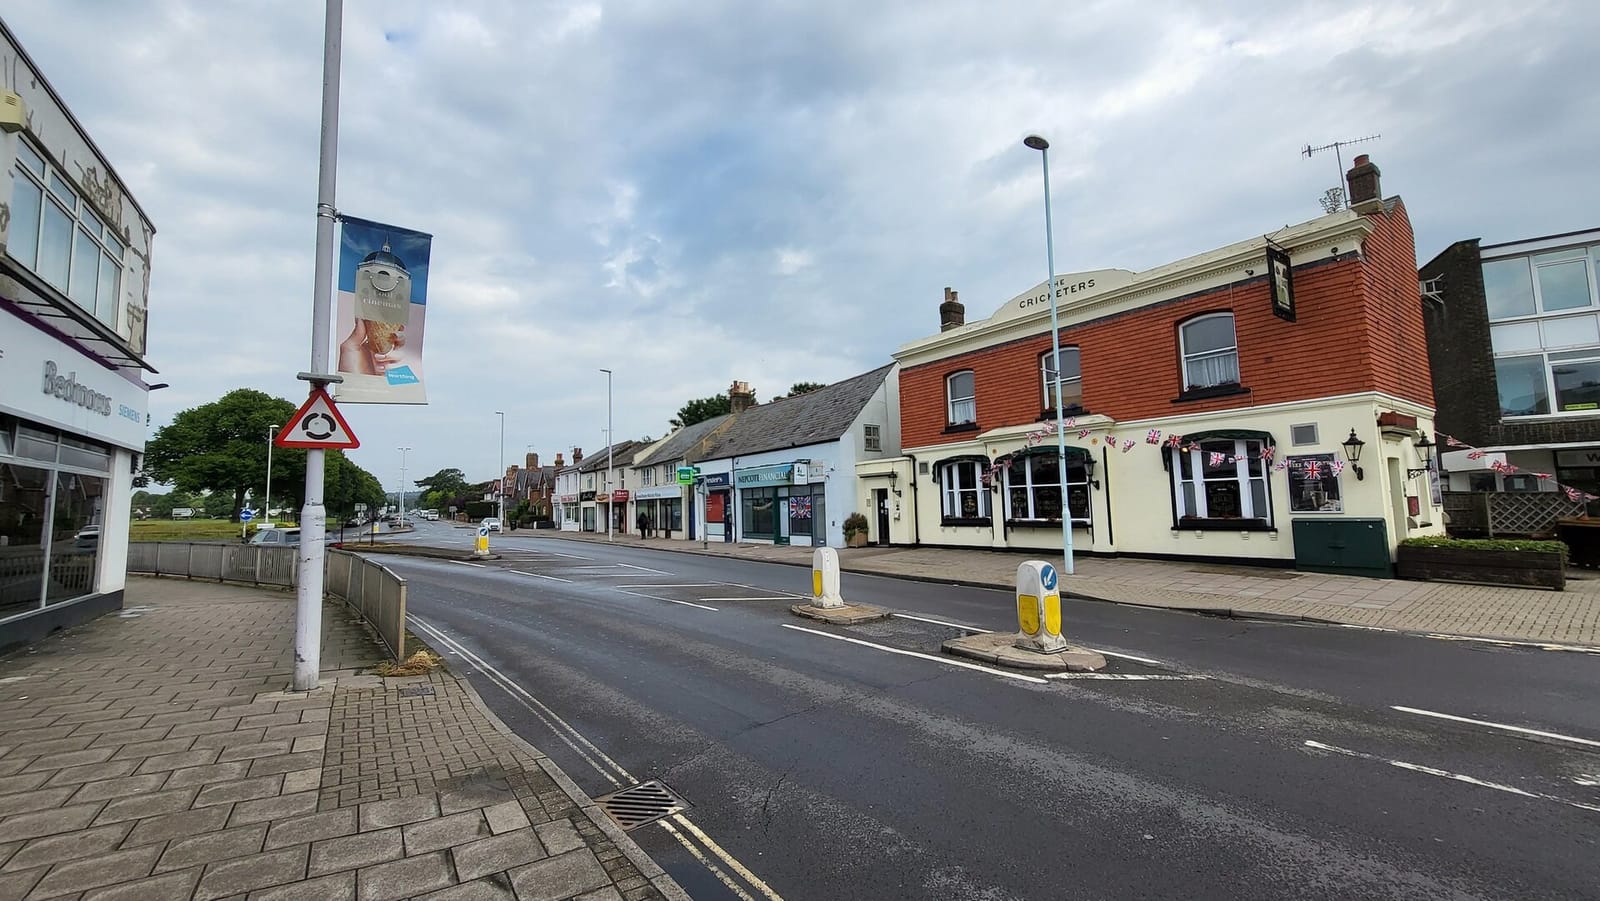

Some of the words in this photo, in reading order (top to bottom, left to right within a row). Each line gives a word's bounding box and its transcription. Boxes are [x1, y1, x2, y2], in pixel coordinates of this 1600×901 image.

[1019, 279, 1096, 309] CRICKETERS
[43, 360, 112, 417] Bedrooms
[118, 404, 140, 423] SIEMENS
[760, 470, 788, 481] FINANCIAL
